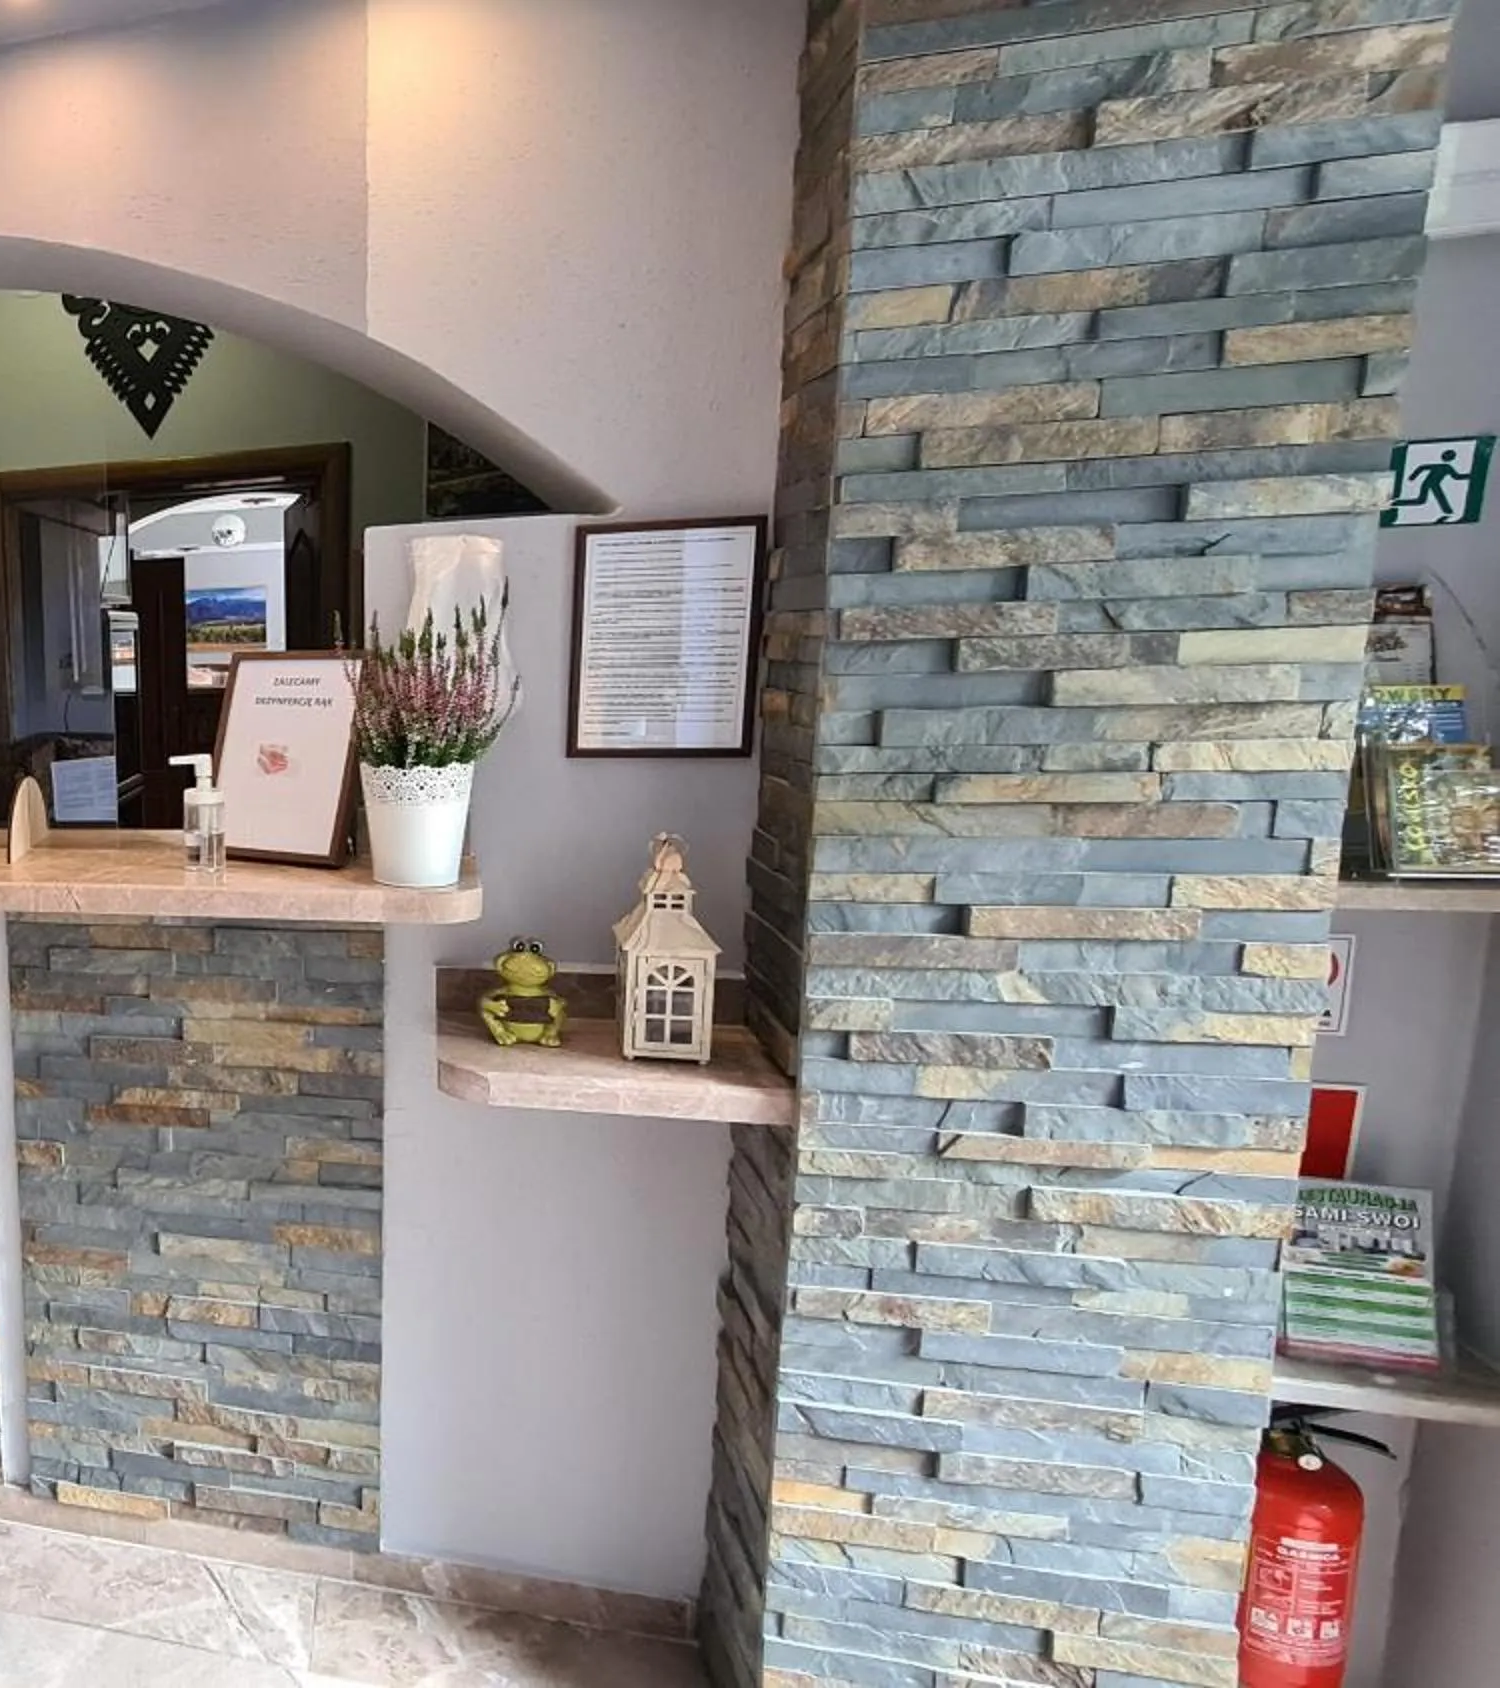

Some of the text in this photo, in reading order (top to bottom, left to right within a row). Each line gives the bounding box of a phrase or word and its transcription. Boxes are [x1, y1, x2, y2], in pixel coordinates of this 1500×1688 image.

[274, 676, 320, 686] ZALECAMY
[255, 696, 313, 707] DEZYNFEKCJĘ
[1298, 1188, 1419, 1213] ESTAURACJA
[1293, 1204, 1347, 1221] SAMI
[1358, 1211, 1420, 1230] SWOI
